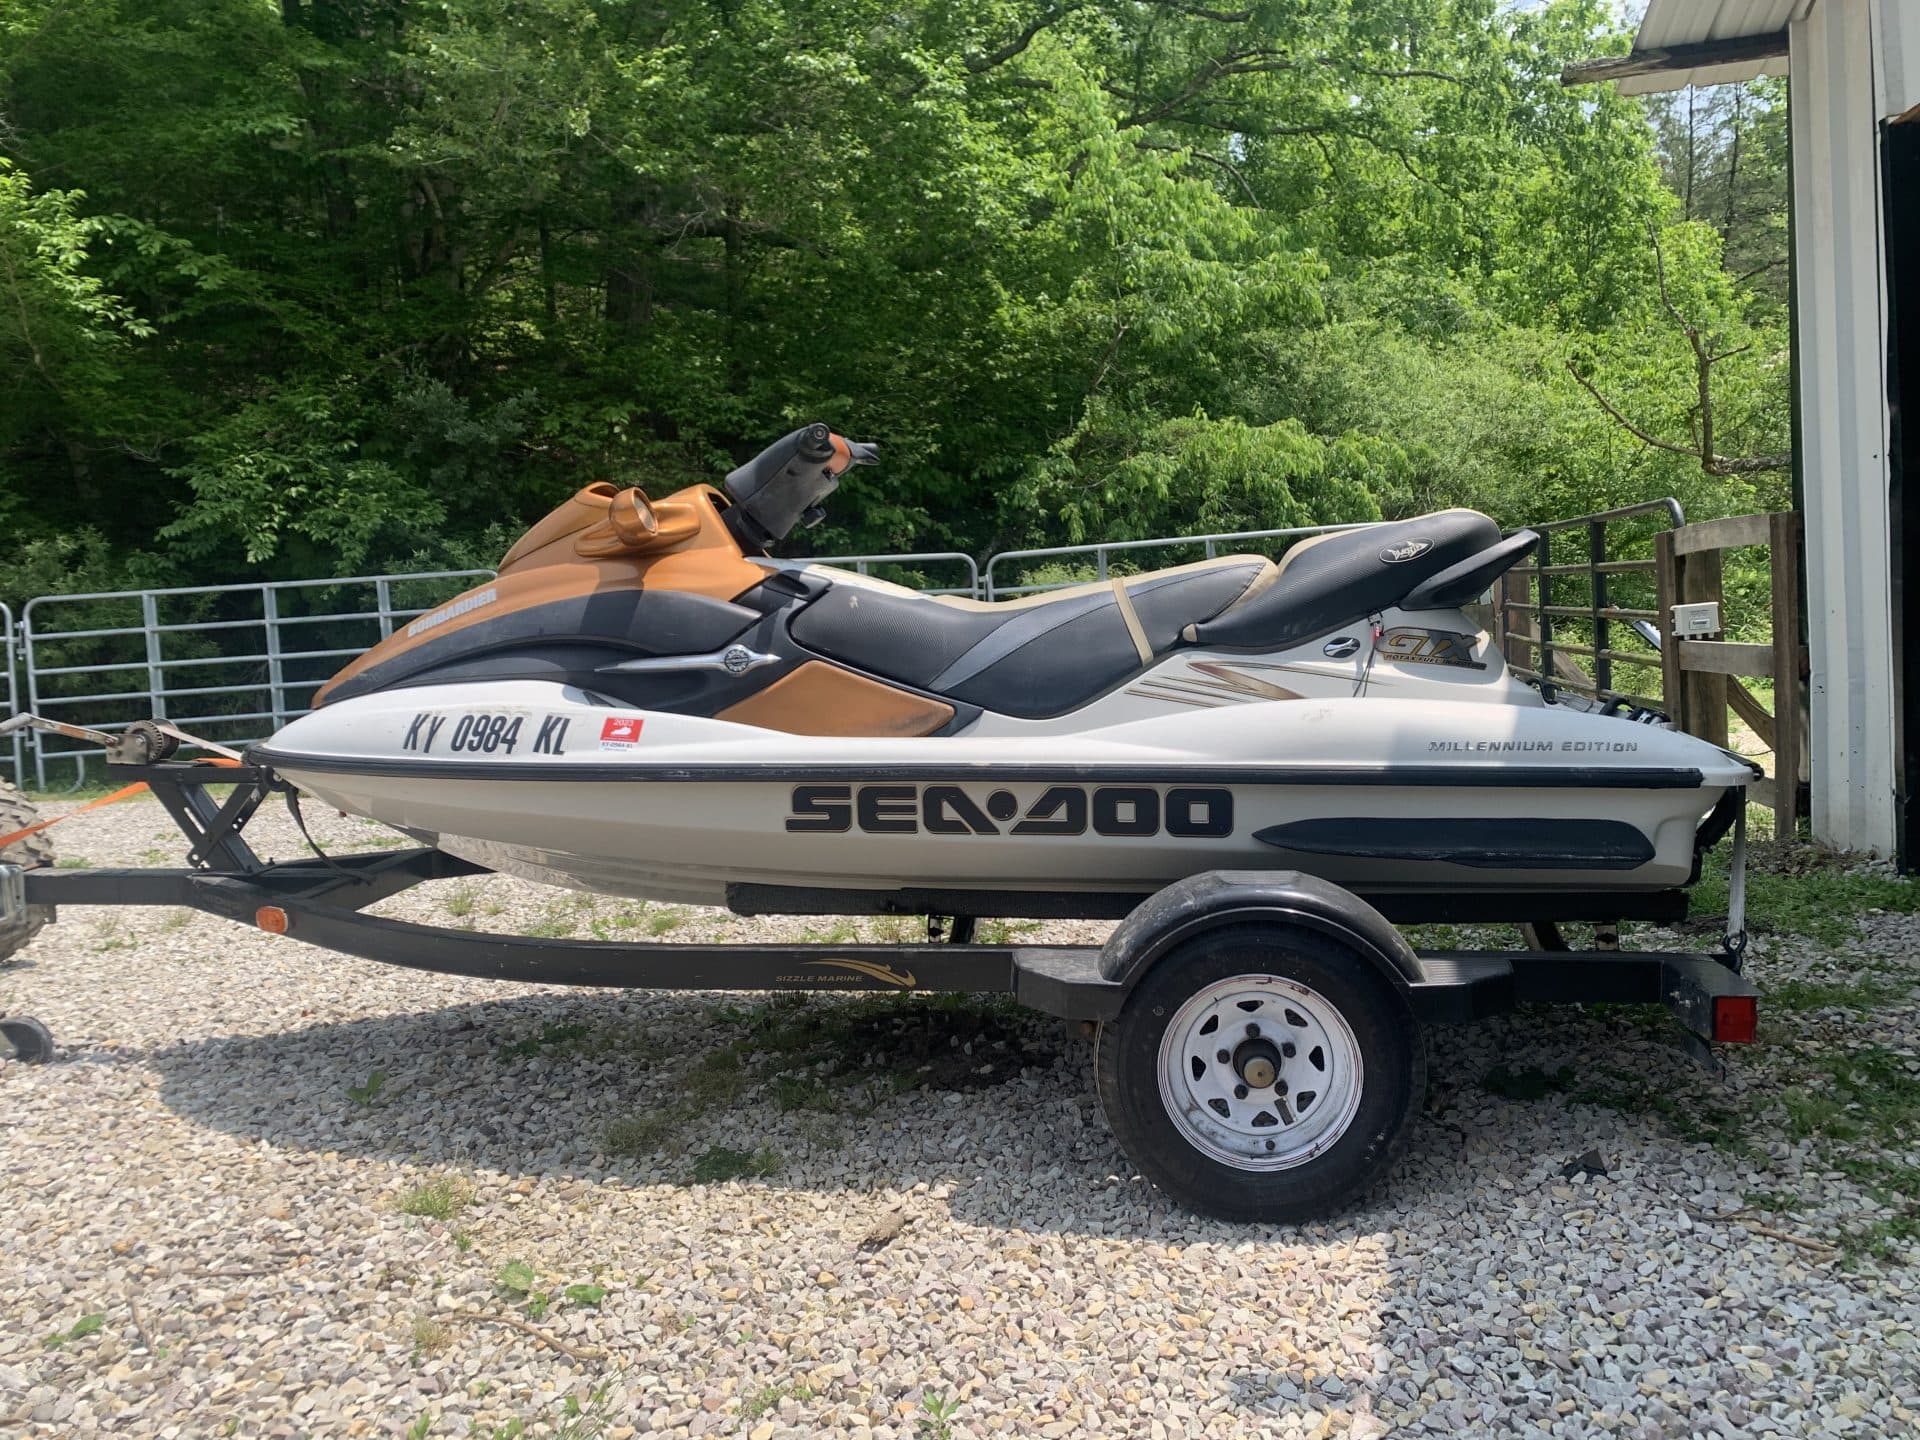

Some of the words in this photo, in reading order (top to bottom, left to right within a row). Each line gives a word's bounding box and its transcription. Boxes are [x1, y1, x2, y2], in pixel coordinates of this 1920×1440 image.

[403, 713, 448, 753] KY
[450, 714, 525, 754] 0984
[532, 714, 572, 755] KL
[1428, 740, 1553, 752] MILLENNIUM
[1561, 740, 1639, 753] EDITION
[775, 974, 815, 983] SIZZLE
[817, 974, 865, 983] MARINE
